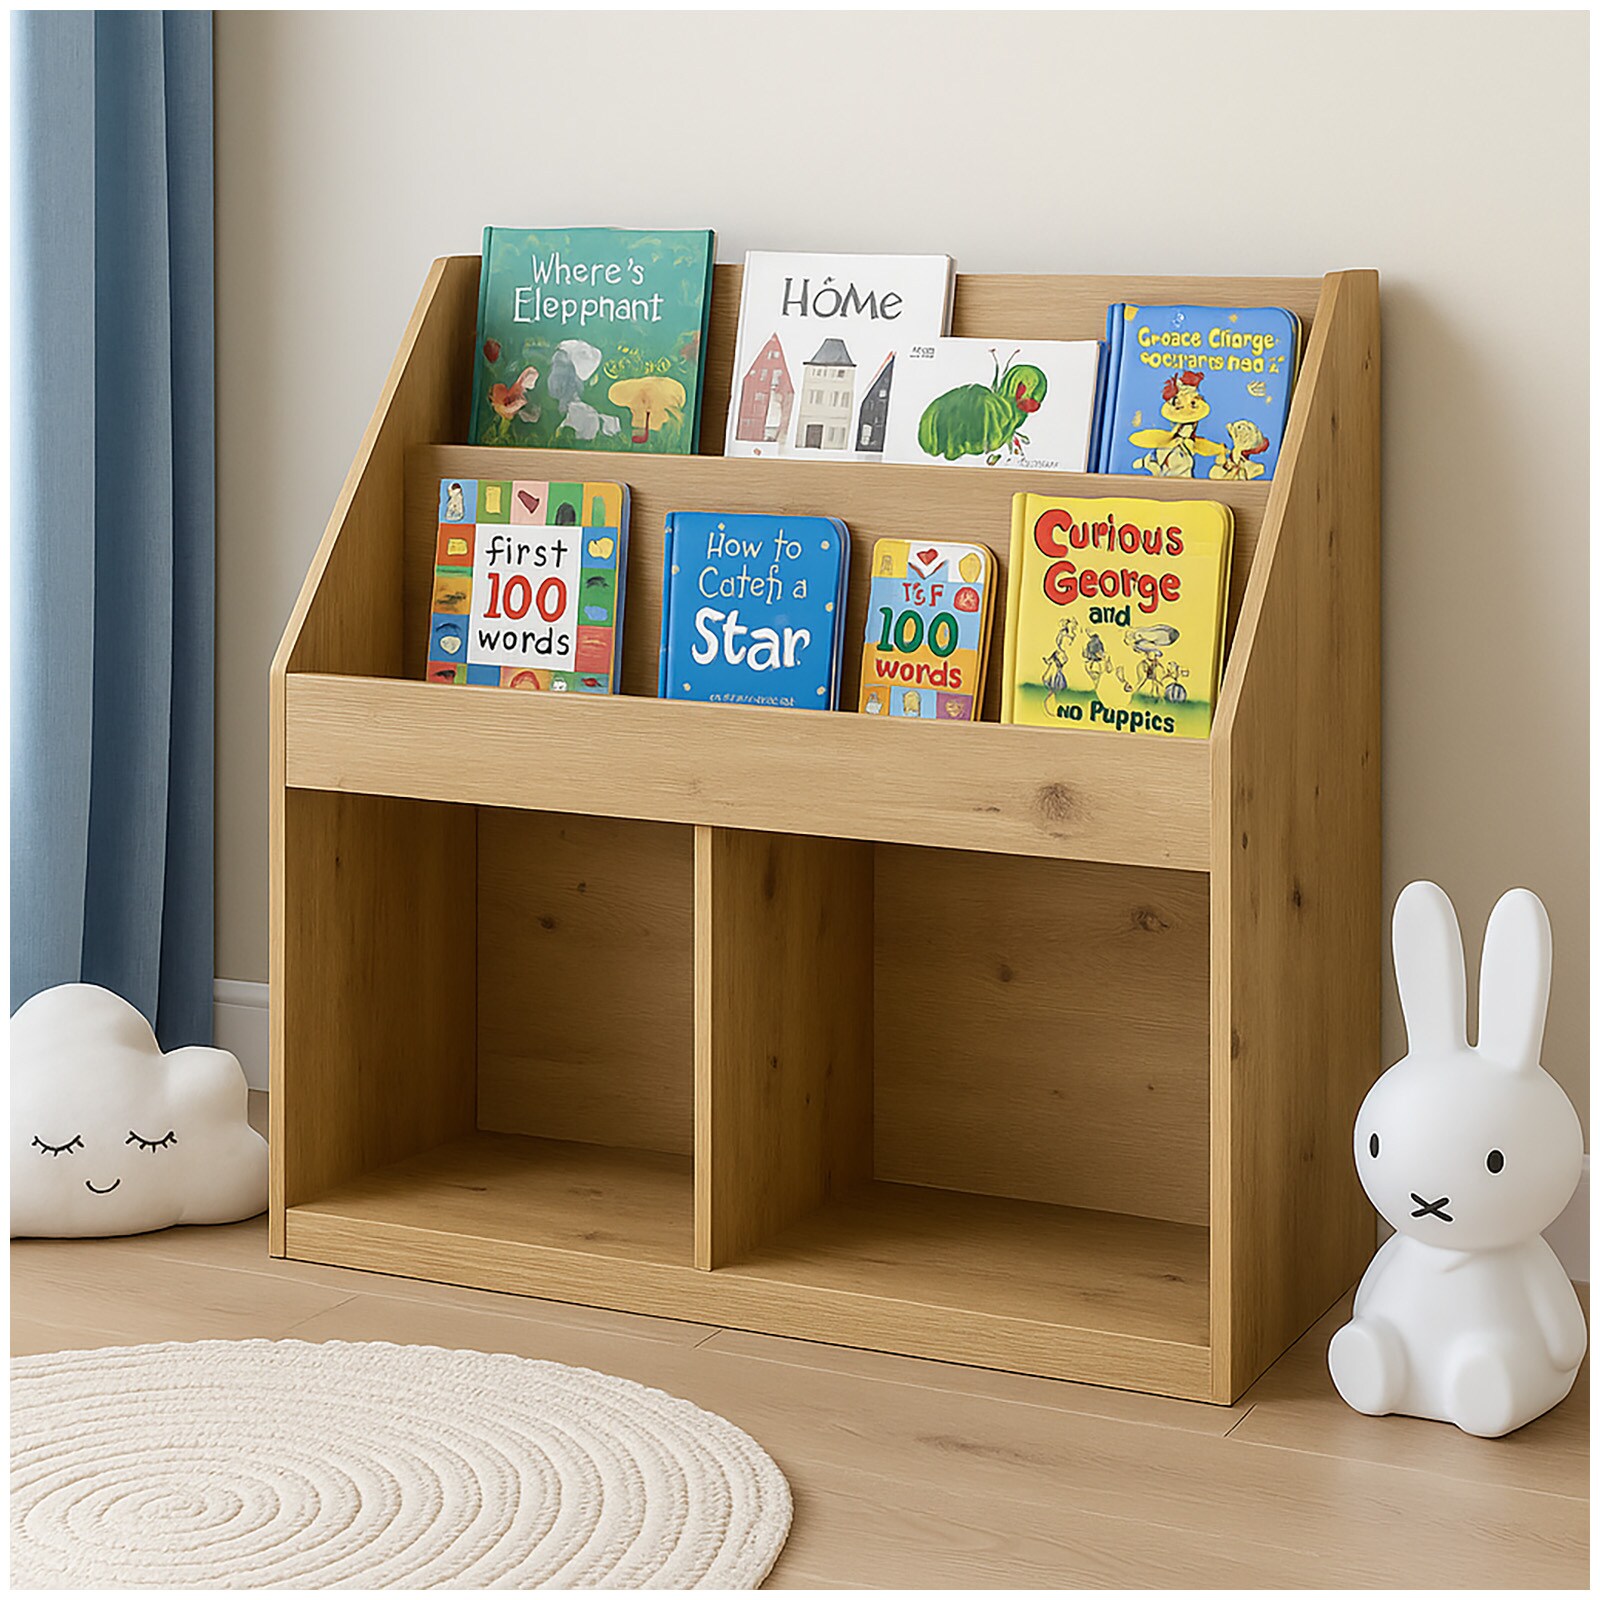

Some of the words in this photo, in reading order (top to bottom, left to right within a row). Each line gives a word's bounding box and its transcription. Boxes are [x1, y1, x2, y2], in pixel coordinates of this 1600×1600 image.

[532, 252, 645, 287] Where's
[706, 529, 763, 560] How
[774, 529, 803, 562] to
[1034, 508, 1184, 558] Curious
[485, 536, 569, 568] first
[483, 572, 567, 623] 100
[792, 578, 807, 599] a
[1043, 560, 1181, 613] George
[876, 607, 959, 658] 100
[1089, 605, 1131, 626] and
[478, 627, 570, 655] words
[691, 606, 811, 672] Star
[875, 658, 962, 689] words
